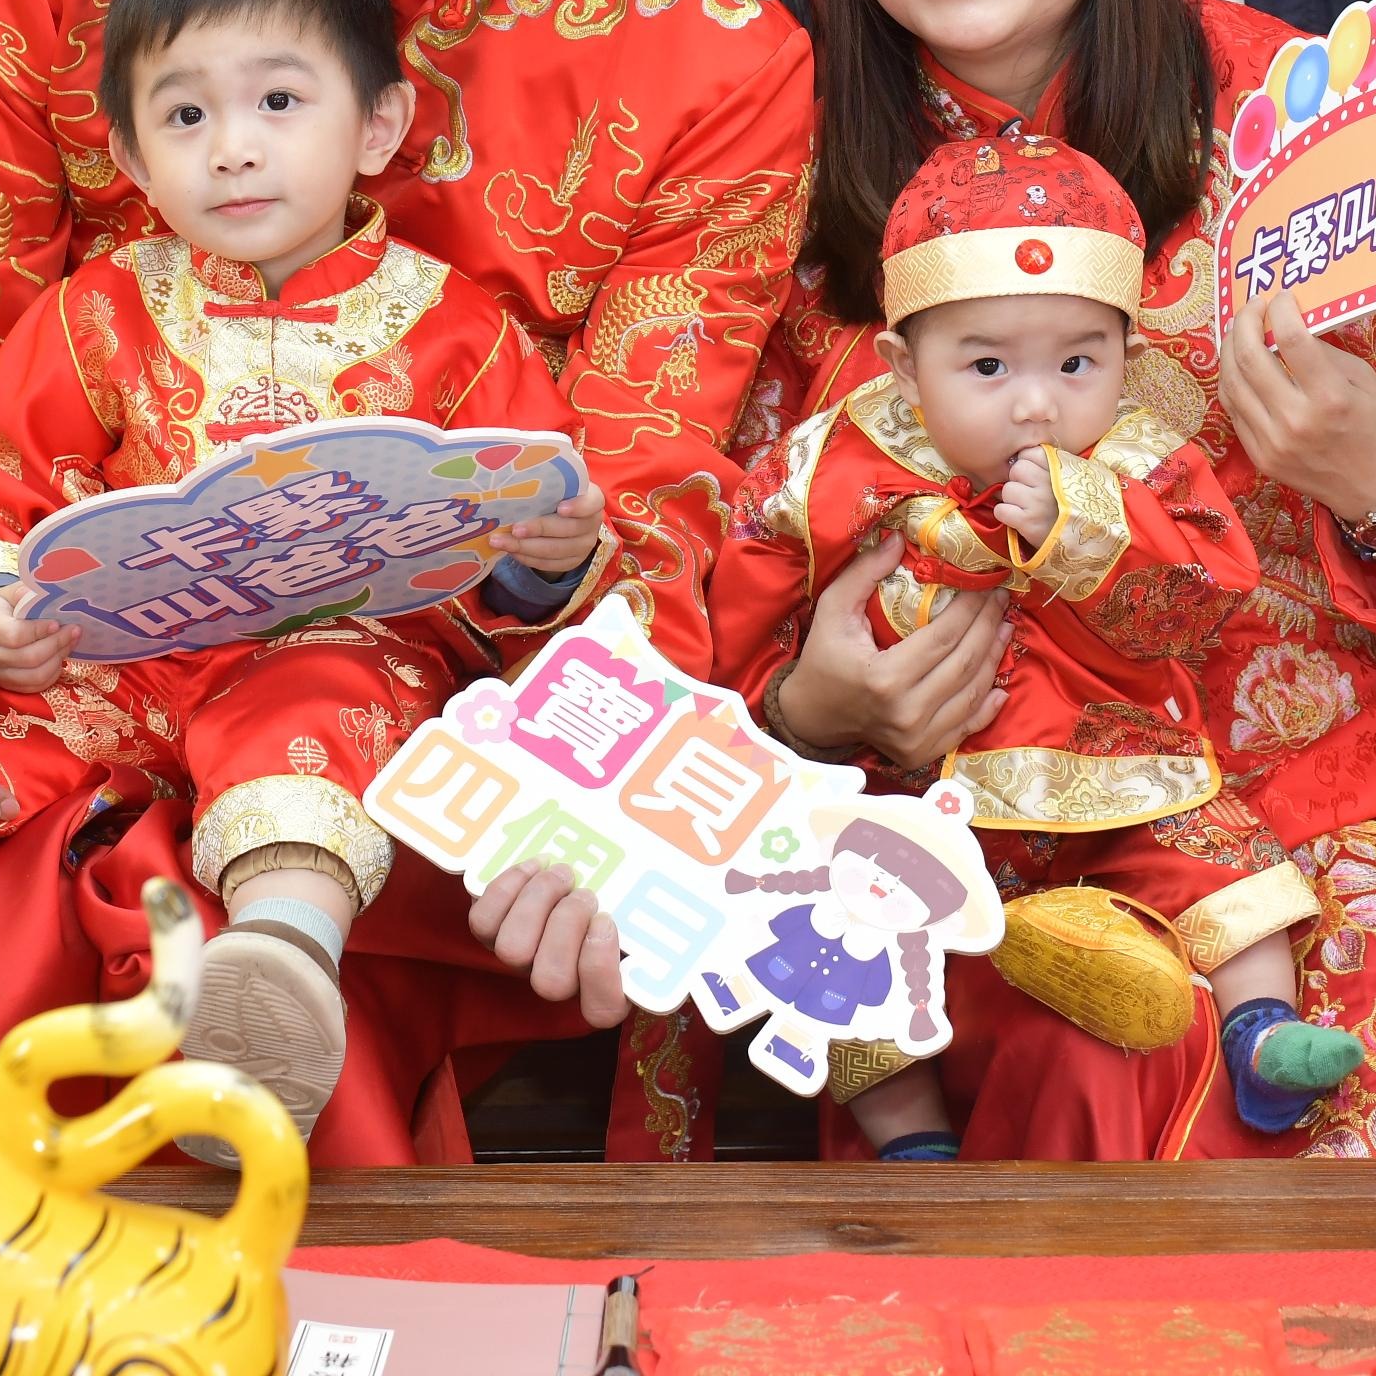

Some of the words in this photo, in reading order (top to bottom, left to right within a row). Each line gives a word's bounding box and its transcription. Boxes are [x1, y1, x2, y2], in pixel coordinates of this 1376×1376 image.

[113, 499, 500, 639] 叫爸爸
[119, 471, 384, 572] 卡緊
[516, 657, 764, 857] 寶貝
[375, 728, 727, 998] 四個月
